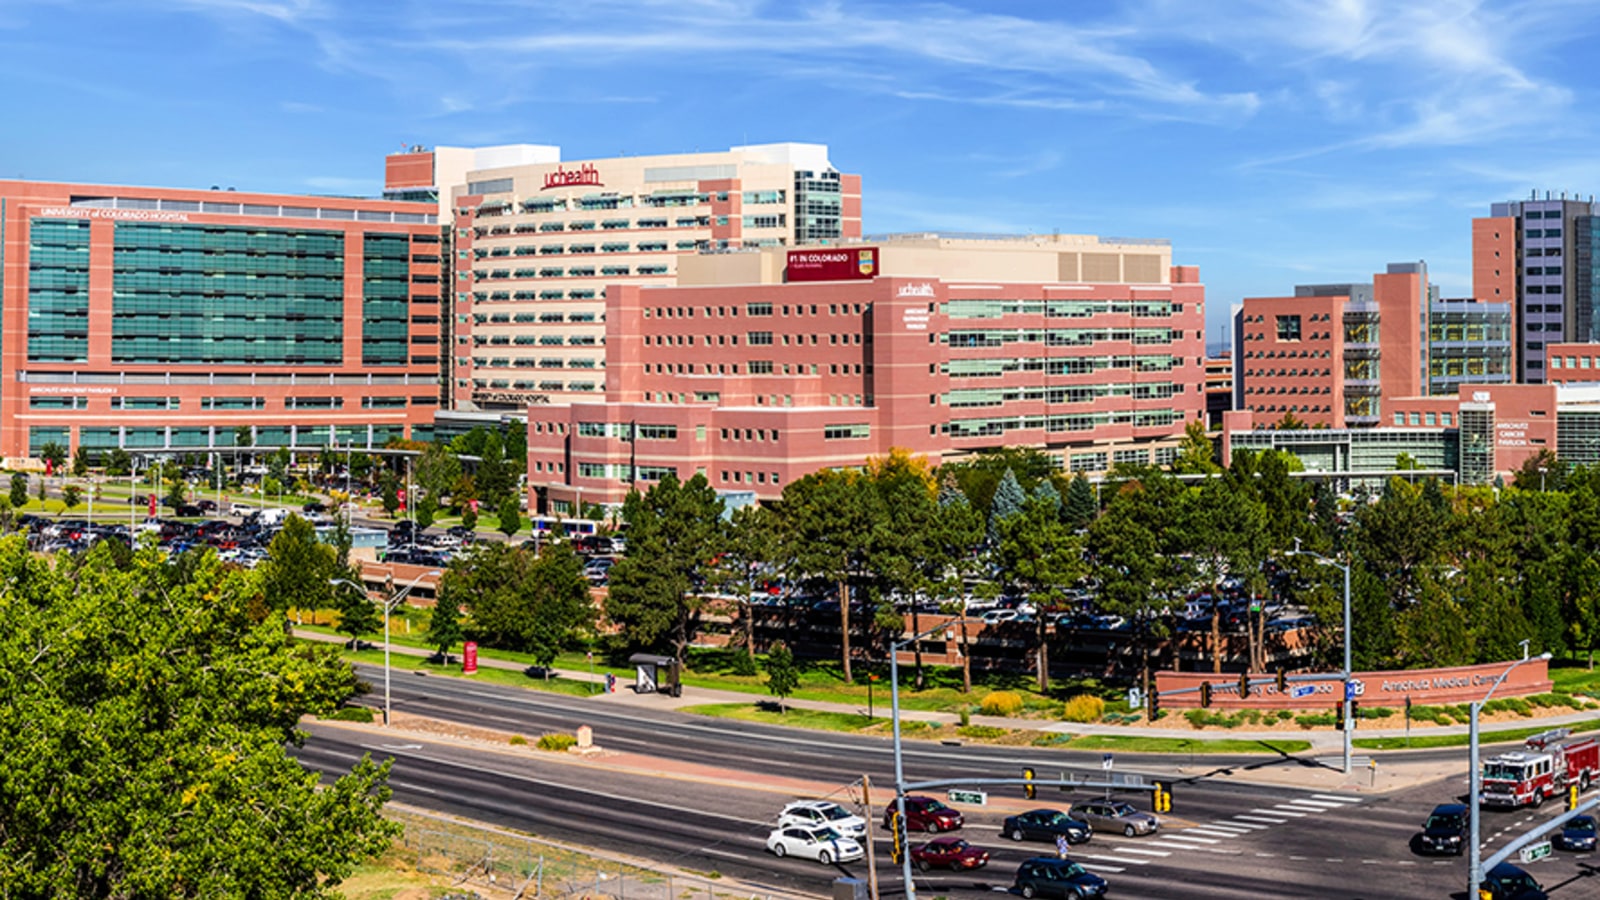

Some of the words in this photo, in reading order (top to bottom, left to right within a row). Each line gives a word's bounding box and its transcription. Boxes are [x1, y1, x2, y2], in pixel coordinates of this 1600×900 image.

[544, 163, 599, 187] uchealth
[41, 208, 91, 217] UNIVERSITY
[101, 210, 148, 219] COLORADO
[150, 212, 189, 221] HOSPITAL
[808, 253, 848, 262] COLORADO
[898, 282, 934, 296] uchealth
[1381, 679, 1430, 692] Anschutz
[1432, 676, 1470, 688] Medical
